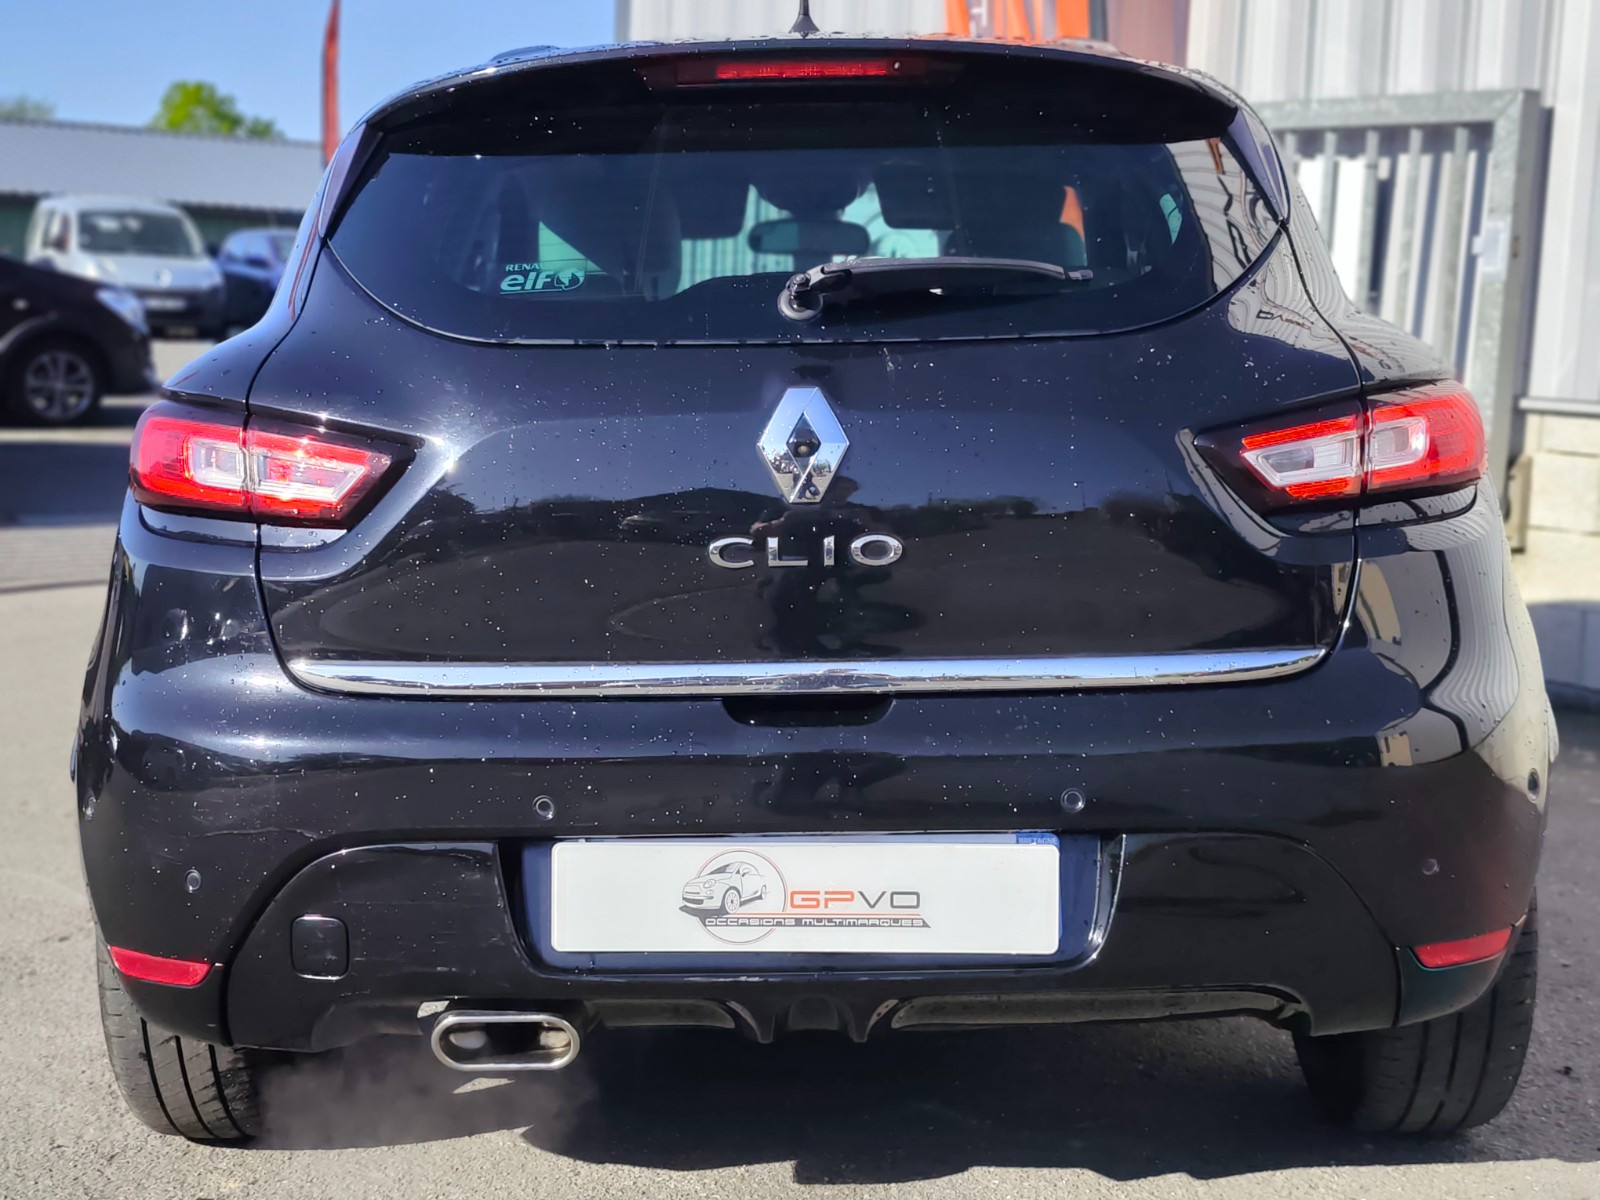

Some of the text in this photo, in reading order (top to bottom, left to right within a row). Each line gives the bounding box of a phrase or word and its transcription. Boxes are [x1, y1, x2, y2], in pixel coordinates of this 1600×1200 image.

[505, 263, 541, 272] RENA
[500, 271, 554, 291] elf
[708, 534, 903, 569] CLIO
